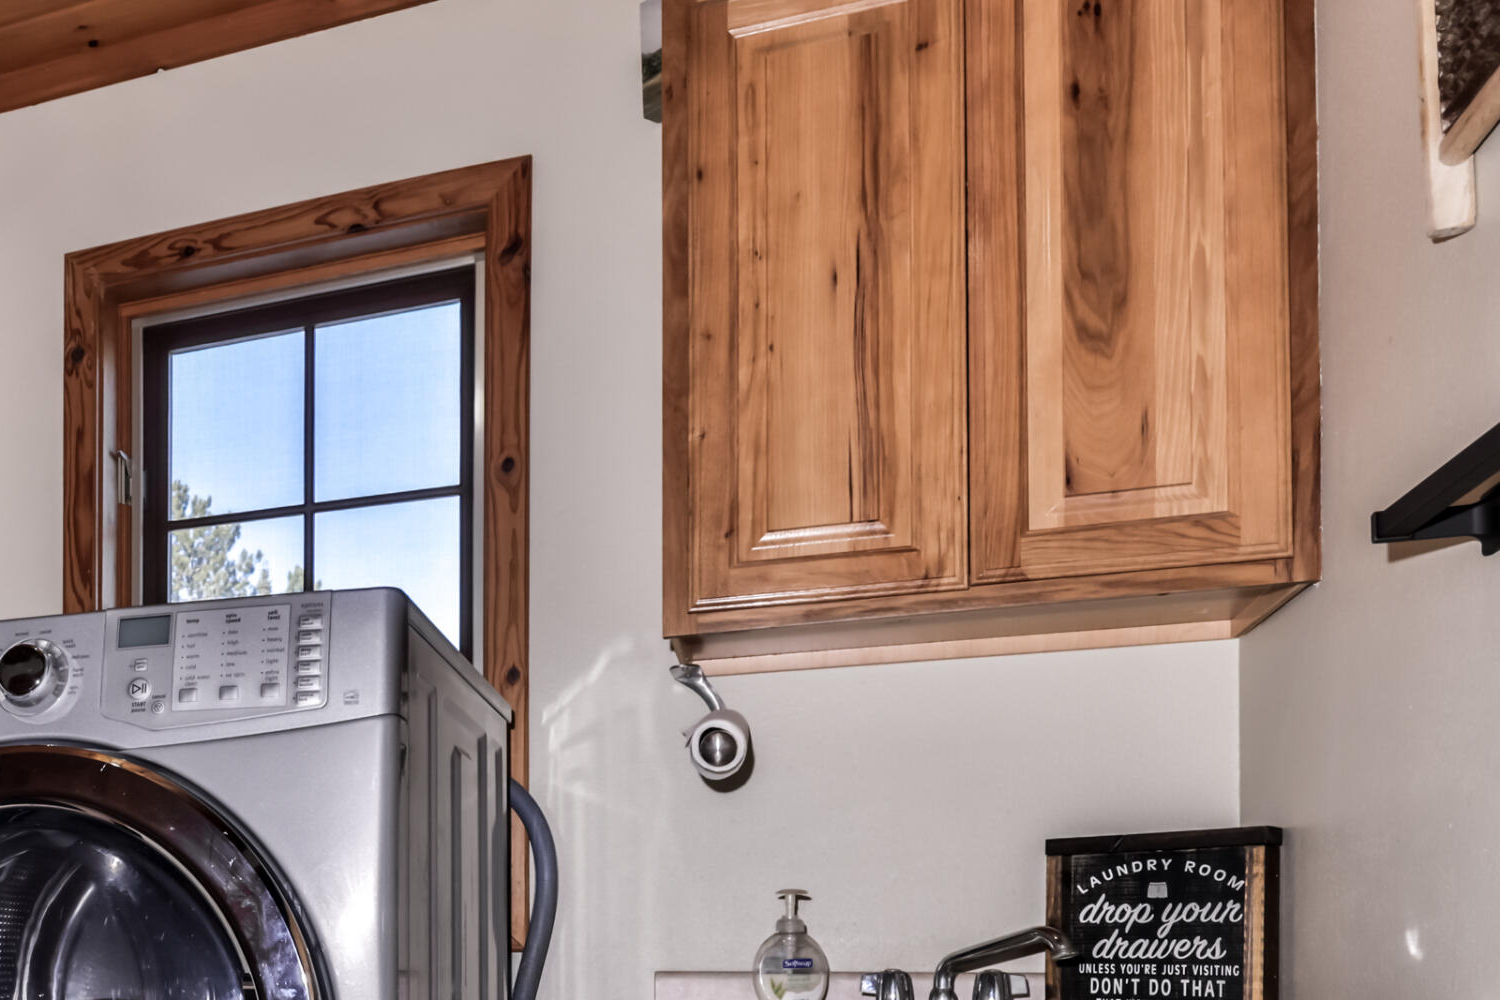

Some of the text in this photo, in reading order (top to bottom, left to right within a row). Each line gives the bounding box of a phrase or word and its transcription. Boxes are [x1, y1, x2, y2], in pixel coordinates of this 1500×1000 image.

[1077, 858, 1245, 895] LAUNDRY ROOM
[1079, 893, 1244, 939] drop your
[1092, 929, 1227, 960] drawers
[1078, 963, 1240, 977] UNLESS YOU'RE JUST VISITING
[1089, 978, 1226, 998] DON'T DO THAT
